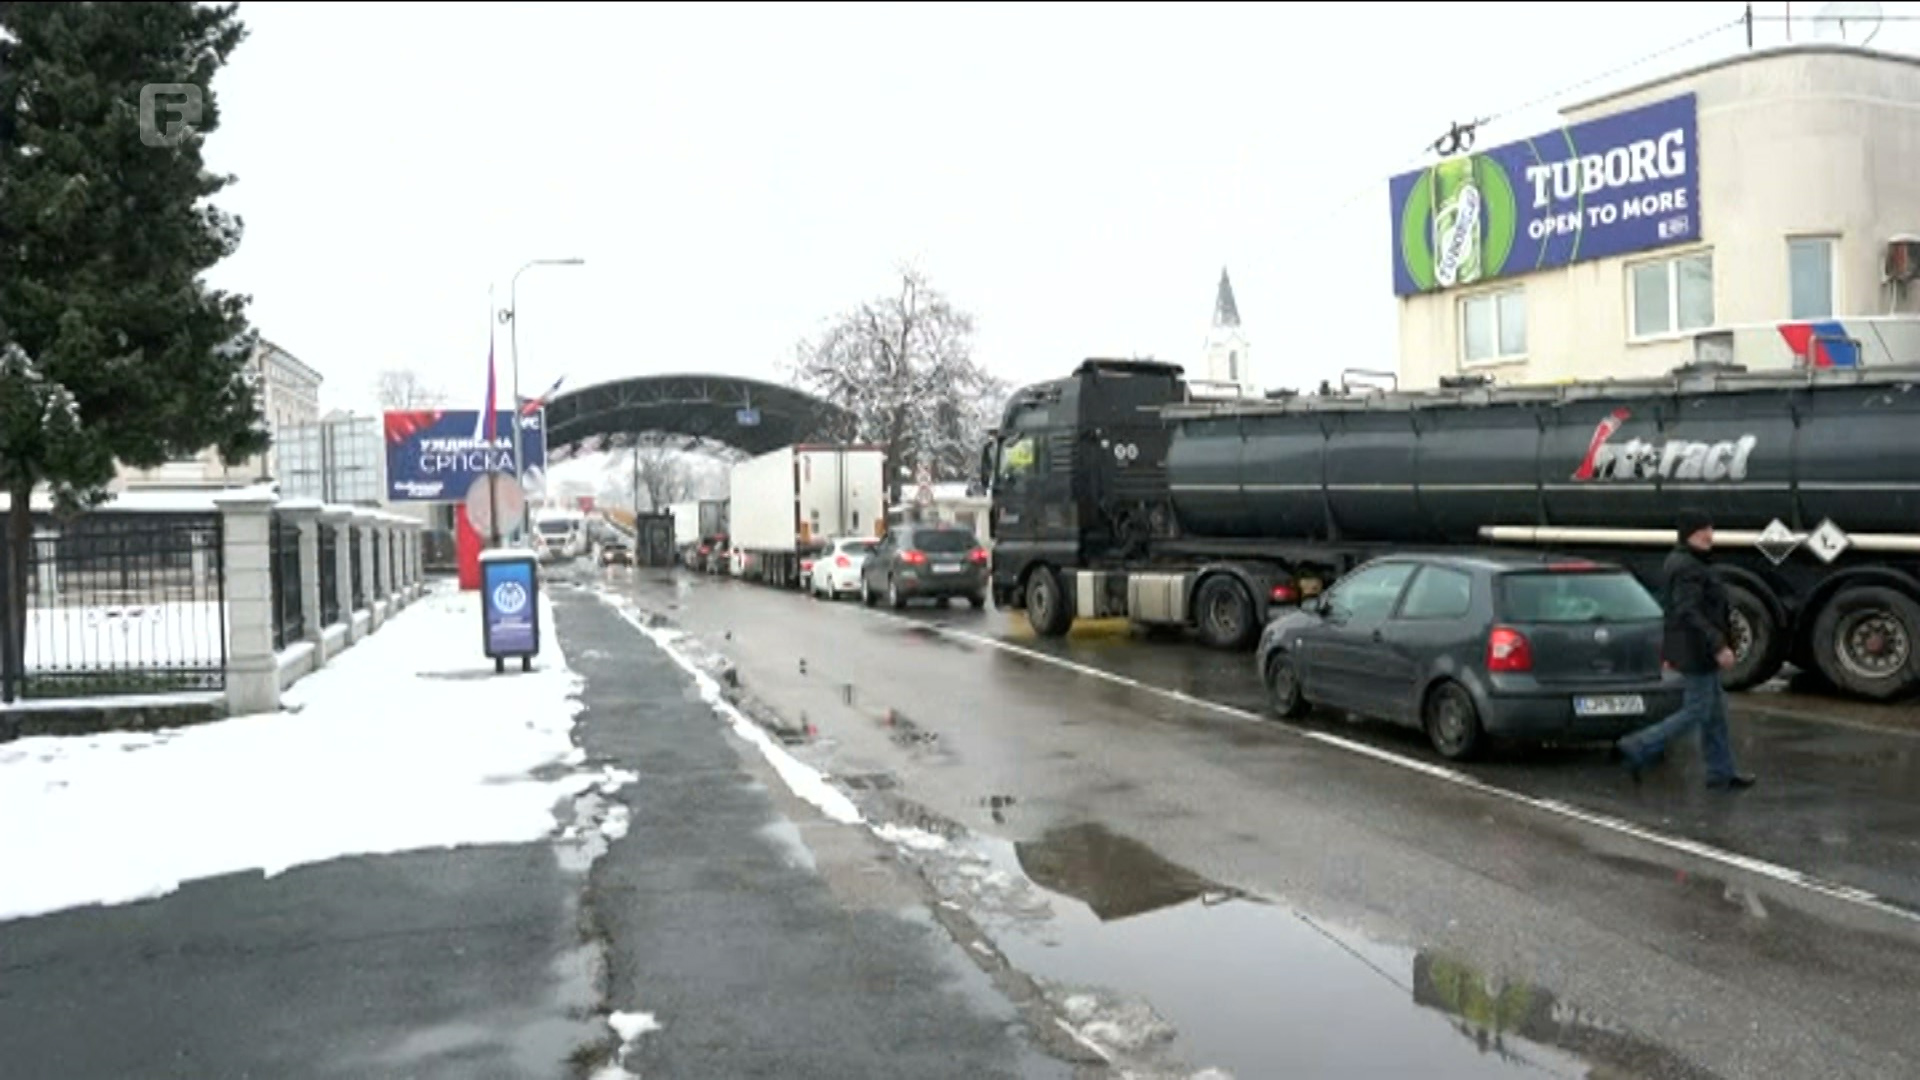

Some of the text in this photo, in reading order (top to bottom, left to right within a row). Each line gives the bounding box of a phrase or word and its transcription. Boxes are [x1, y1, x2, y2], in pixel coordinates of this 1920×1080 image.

[1526, 128, 1687, 209] TUBORG
[1527, 188, 1689, 240] OPEN TO MORE
